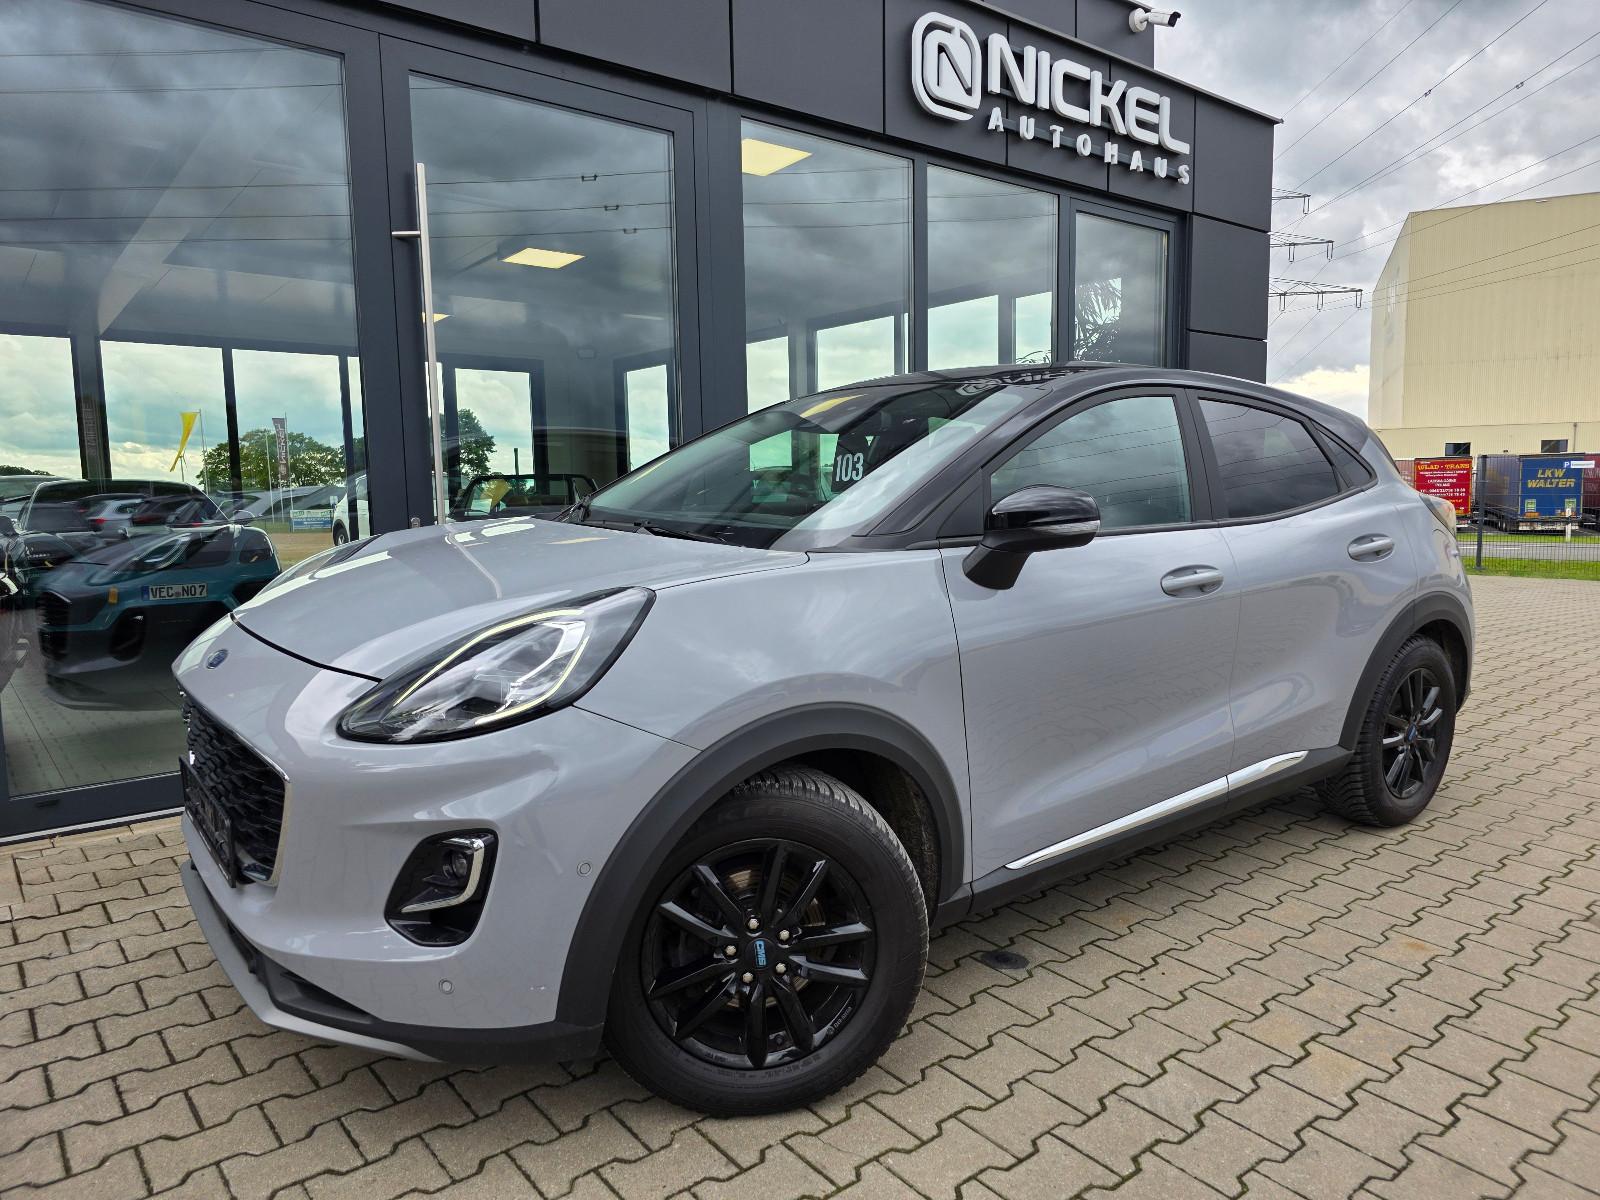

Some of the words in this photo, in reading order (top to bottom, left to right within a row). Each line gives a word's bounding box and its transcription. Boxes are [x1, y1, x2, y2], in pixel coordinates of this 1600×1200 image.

[988, 33, 1190, 155] NICKEL
[988, 107, 1190, 185] AUTOHAUS
[836, 452, 863, 482] 103
[1537, 468, 1566, 478] LKW
[1527, 478, 1576, 488] WALTER
[150, 586, 174, 599] VEC
